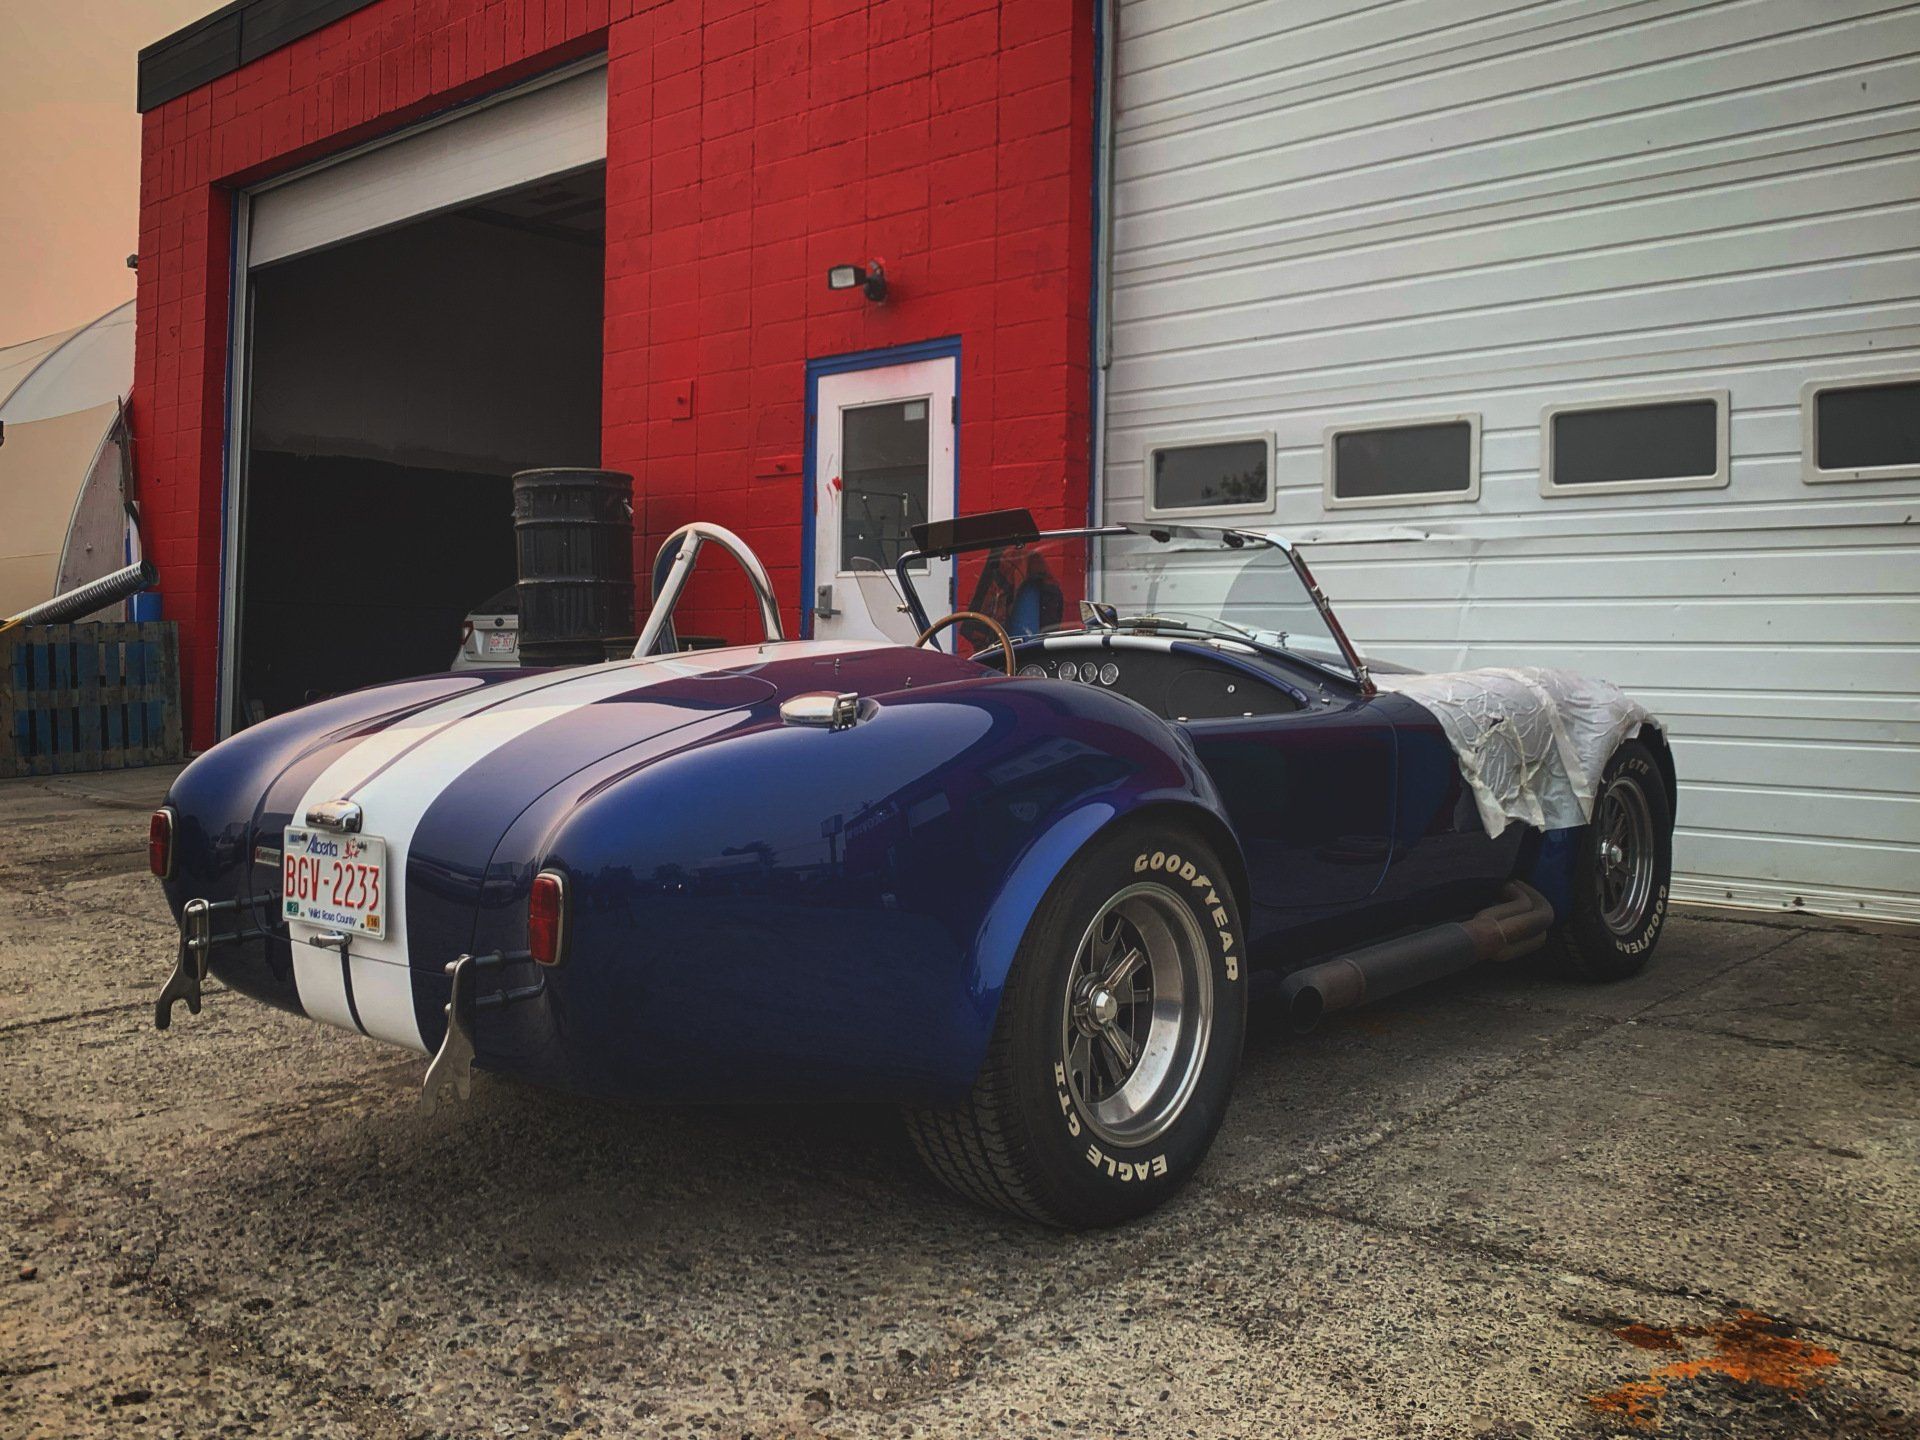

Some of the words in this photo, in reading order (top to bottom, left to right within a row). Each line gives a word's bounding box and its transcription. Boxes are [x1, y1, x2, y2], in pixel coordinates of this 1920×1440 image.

[306, 833, 338, 857] Alberta
[285, 855, 380, 911] BGV-2233
[308, 907, 321, 919] Wild
[1134, 851, 1238, 982] GOODYEAR
[1086, 1144, 1168, 1182] EAGLE
